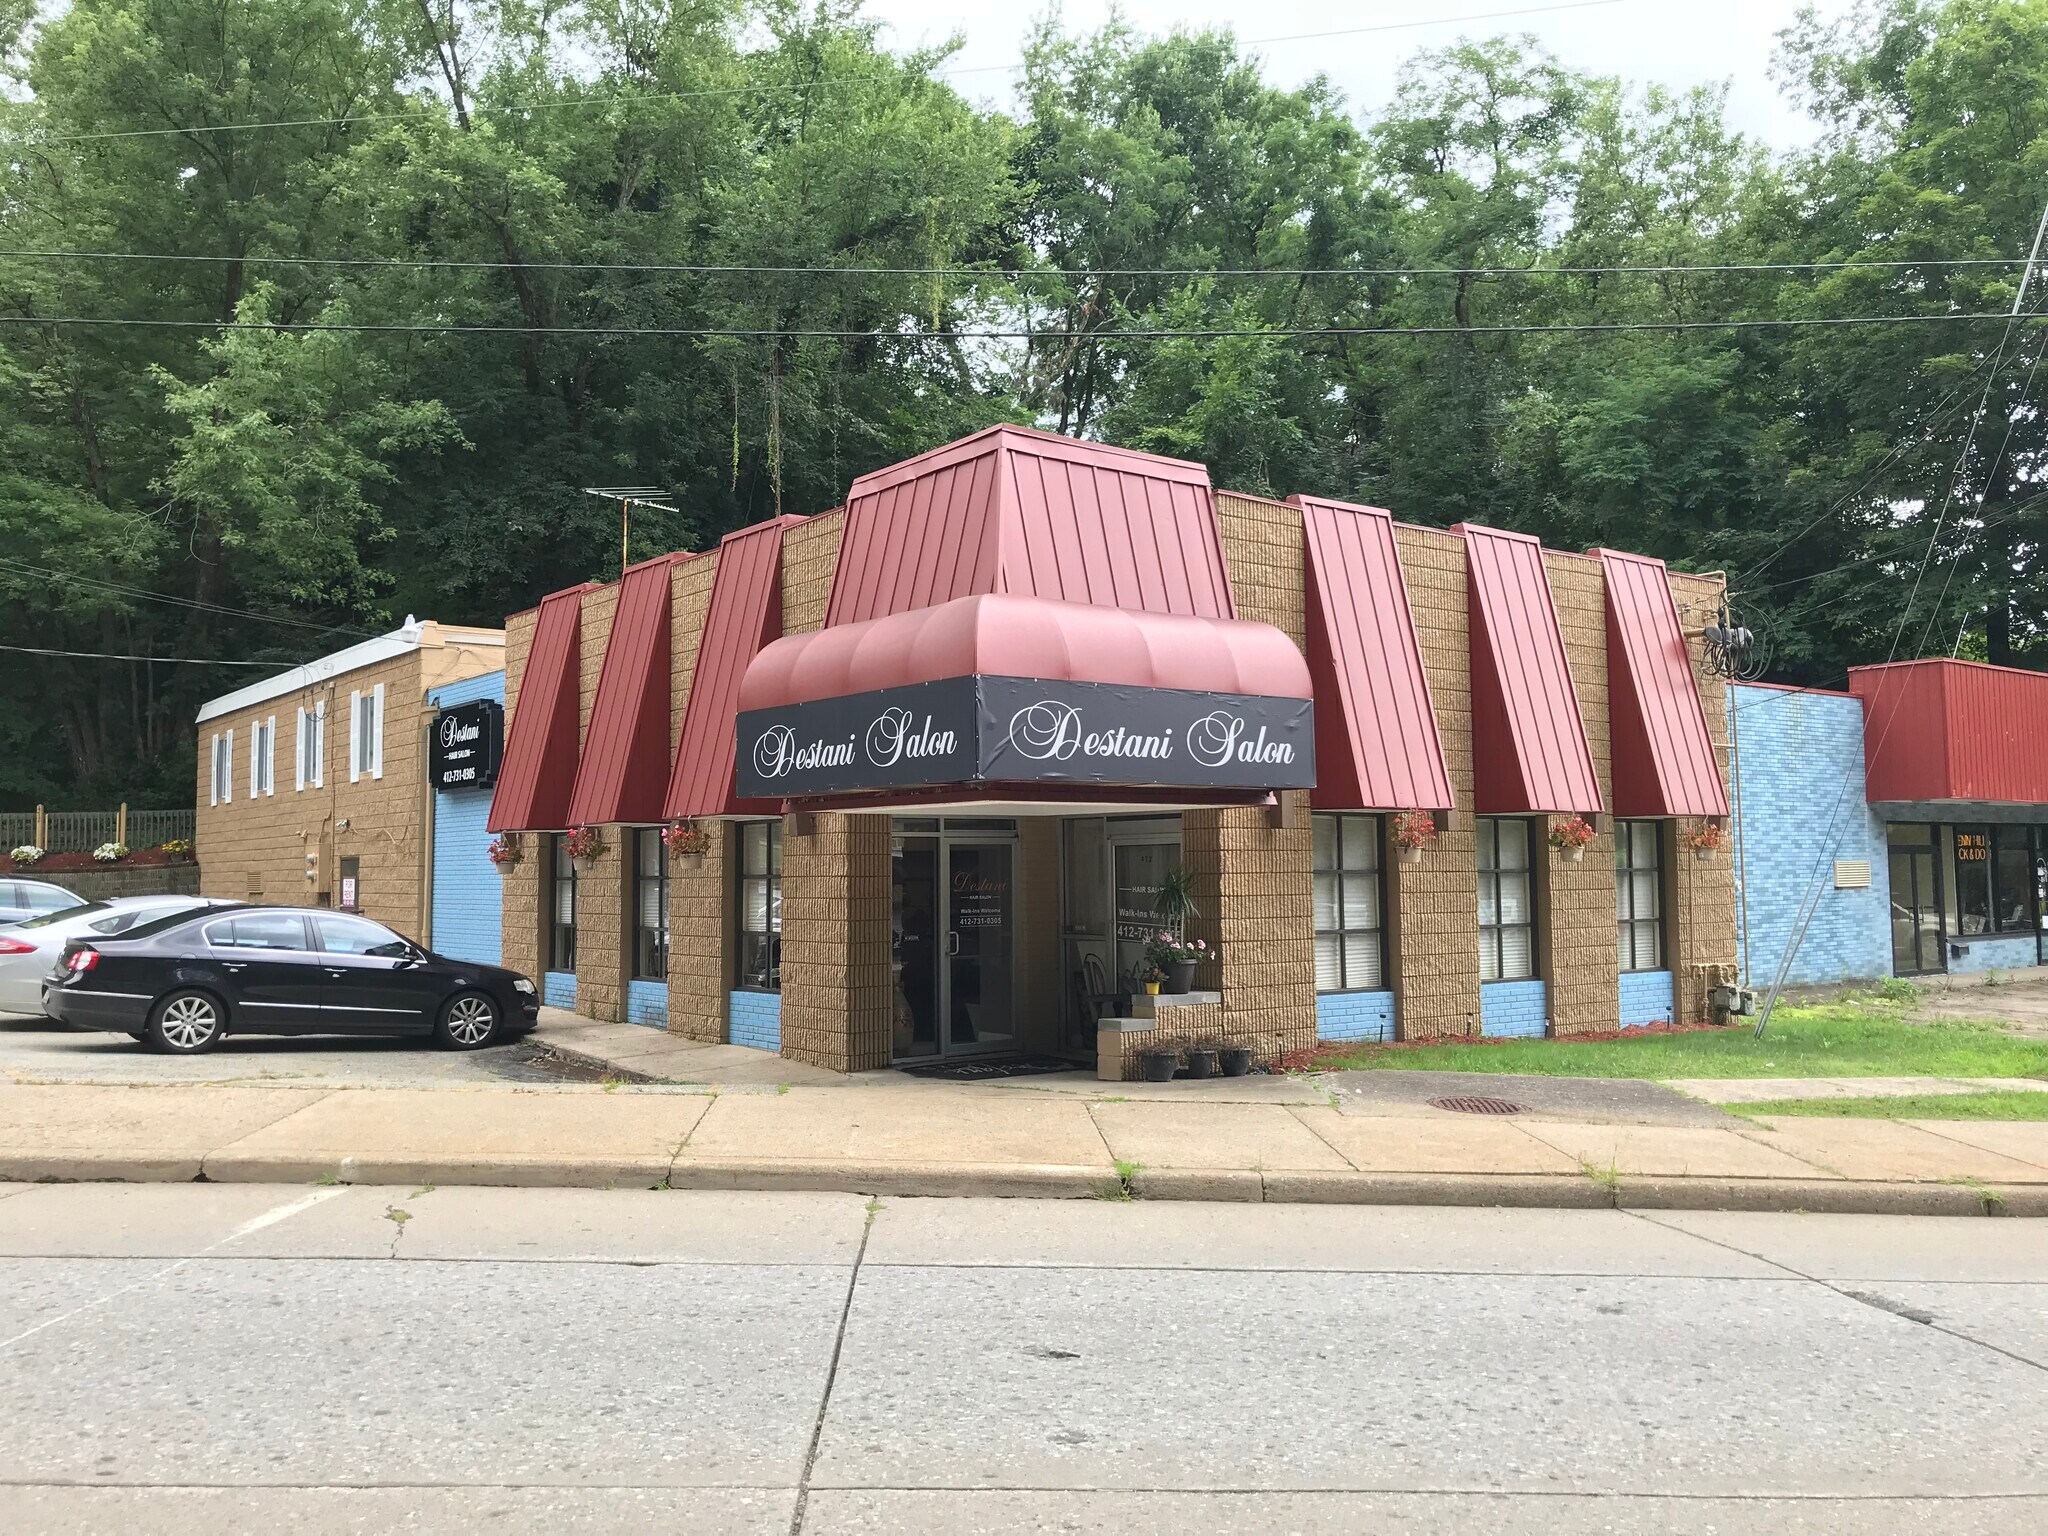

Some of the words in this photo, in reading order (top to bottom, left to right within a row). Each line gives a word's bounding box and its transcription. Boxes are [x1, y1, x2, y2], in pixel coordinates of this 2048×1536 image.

[440, 715, 480, 748] Destani
[1009, 700, 1174, 760] Destani
[1187, 710, 1295, 767] Salon
[753, 724, 857, 779] Destani
[865, 706, 958, 768] Salon
[448, 751, 458, 760] HAIR
[458, 749, 471, 758] SALON
[443, 767, 475, 783] 412-731-0305
[953, 871, 1008, 892] Destani
[960, 917, 1002, 925] 412-731-0305
[1119, 908, 1148, 918] Walk-Ins
